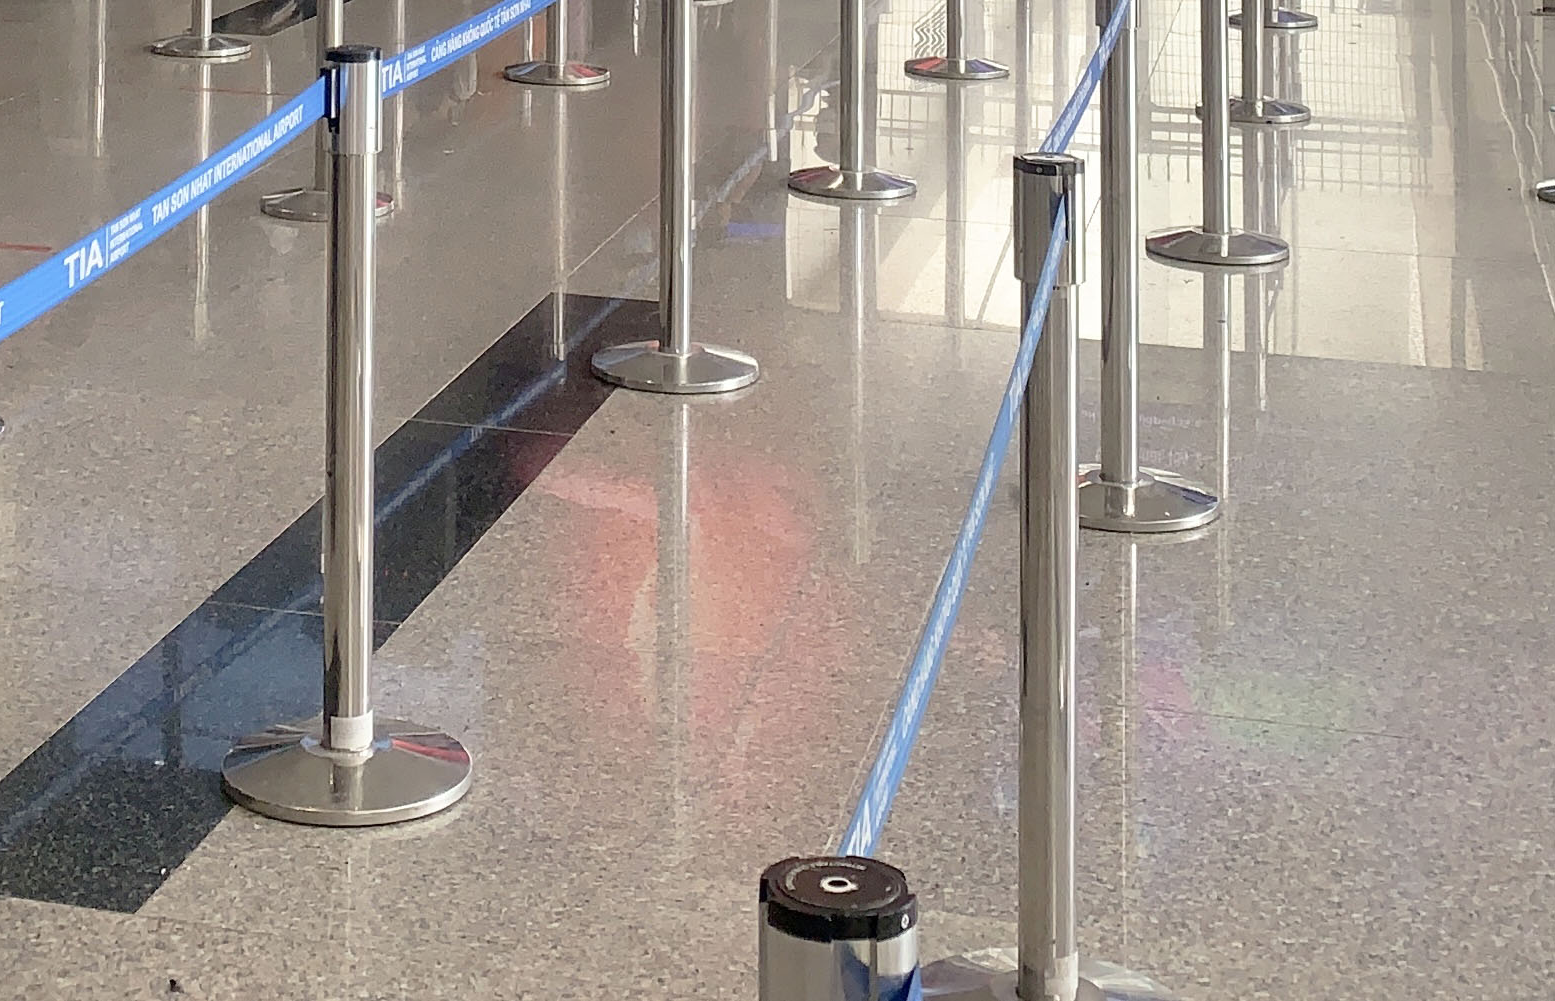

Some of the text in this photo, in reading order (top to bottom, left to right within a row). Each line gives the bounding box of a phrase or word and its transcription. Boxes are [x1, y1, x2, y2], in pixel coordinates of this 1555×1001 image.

[382, 59, 403, 92] TIA
[151, 104, 304, 227] TAN SON NHAT INTERNATIONAL AIRPORT
[63, 238, 103, 288] TIA
